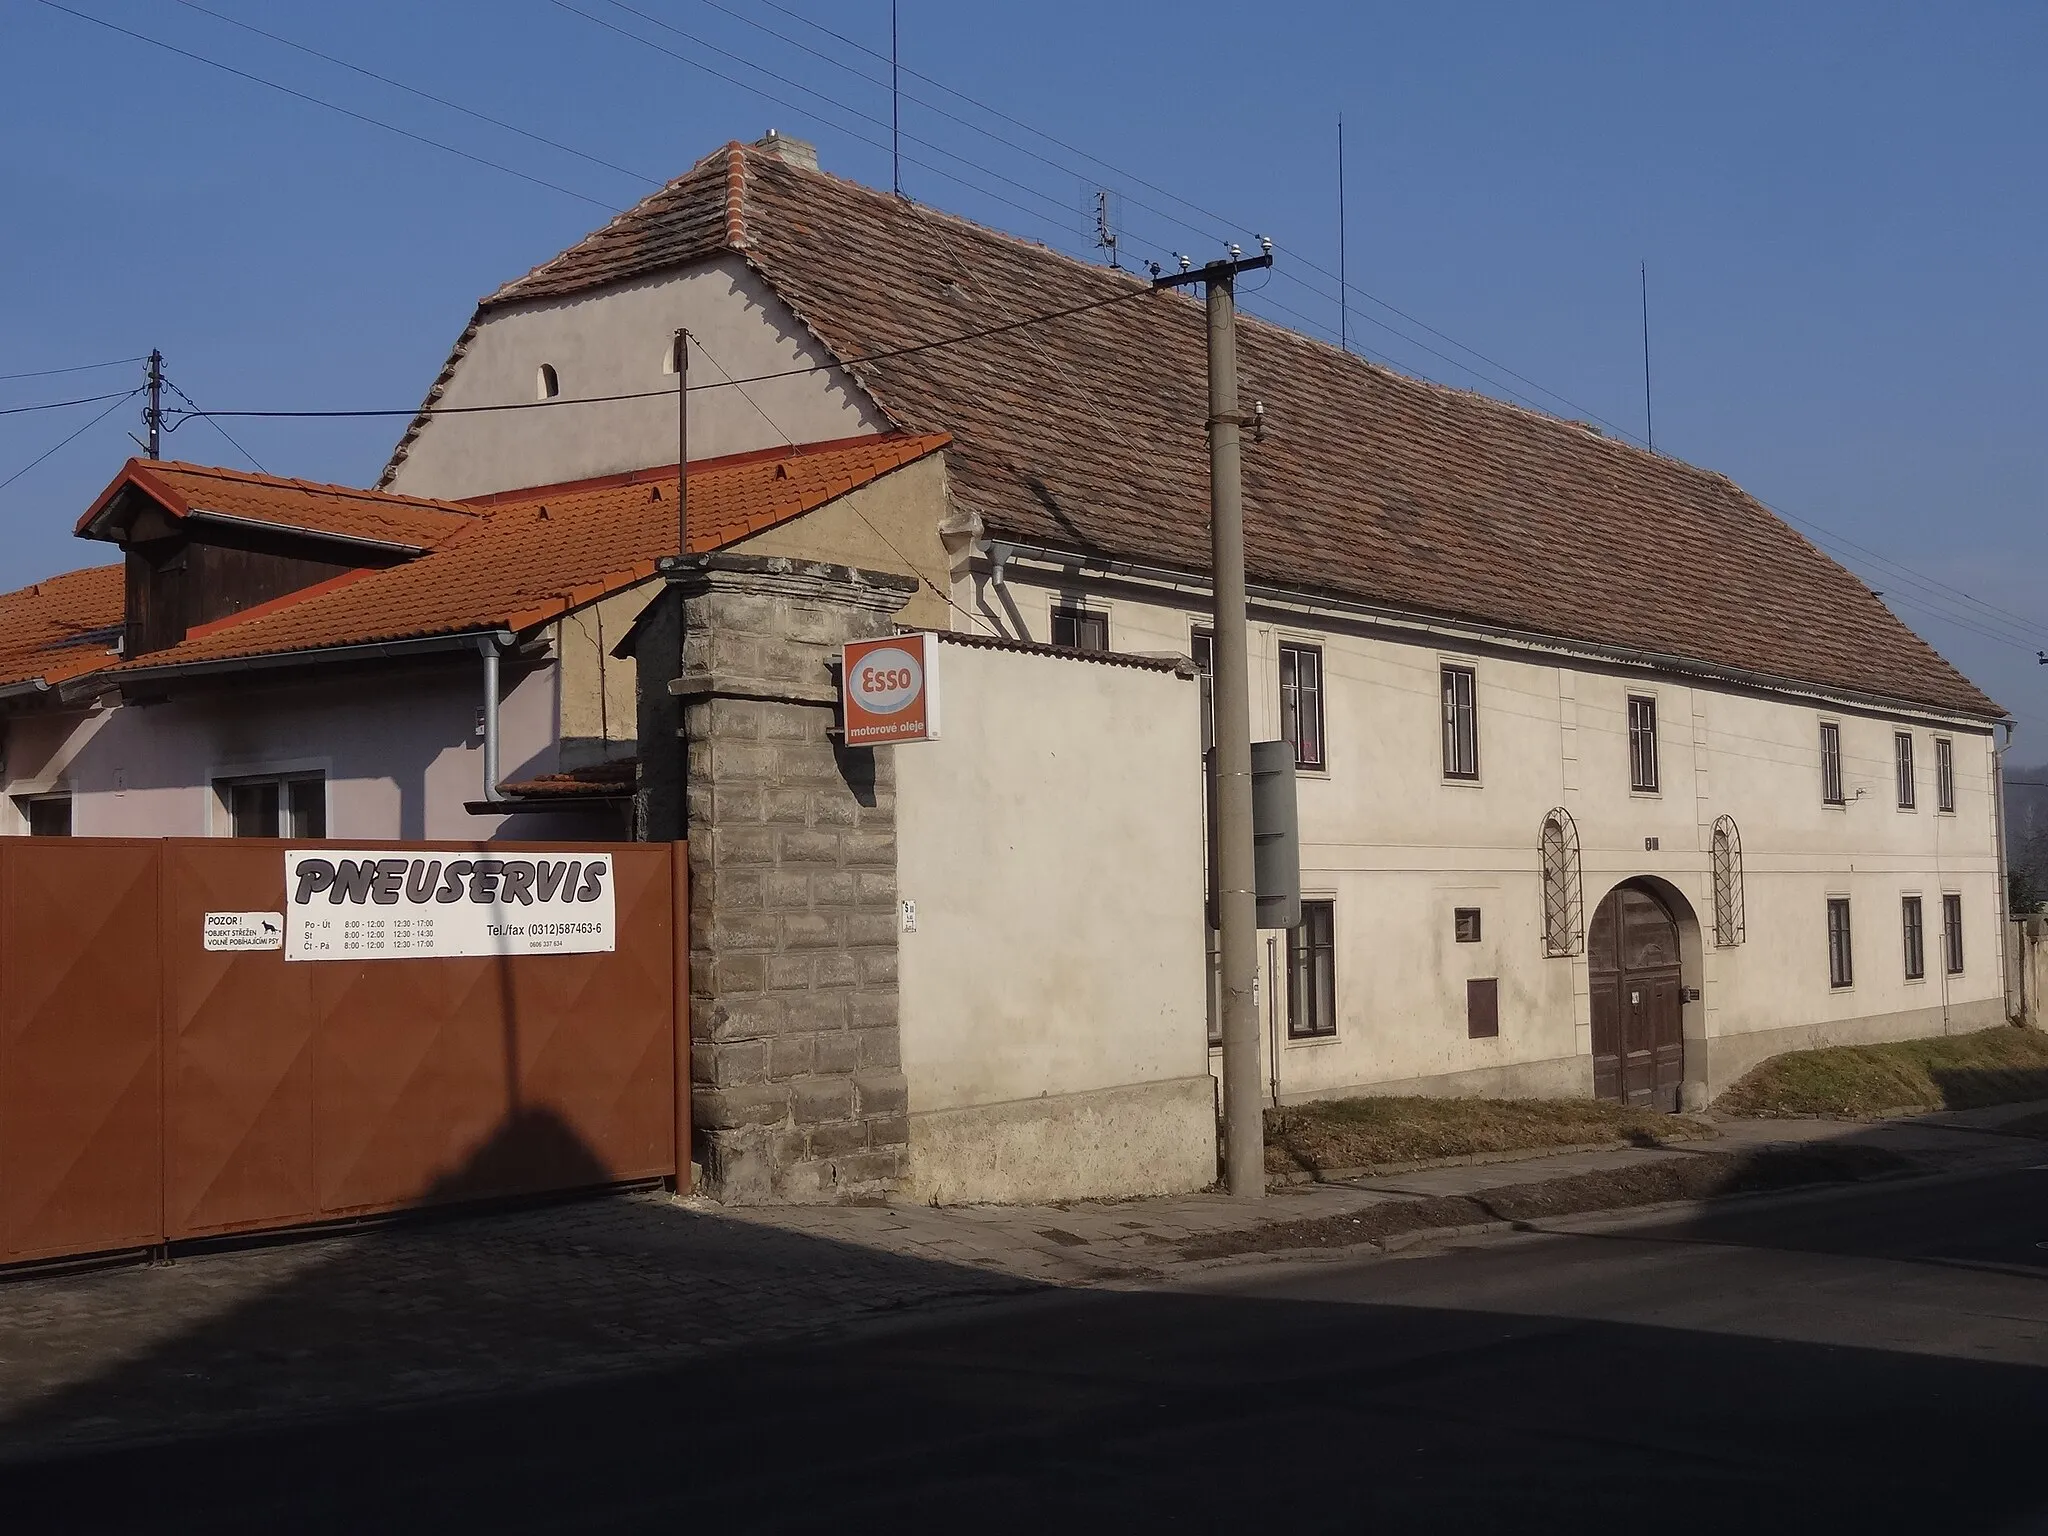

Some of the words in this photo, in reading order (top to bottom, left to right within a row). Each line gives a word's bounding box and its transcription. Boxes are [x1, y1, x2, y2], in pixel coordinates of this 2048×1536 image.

[850, 722, 897, 737] motorové
[900, 720, 924, 733] oleje
[295, 858, 607, 906] PNEUSERVIS
[208, 916, 238, 925] POZOR
[305, 921, 315, 929] Po
[344, 920, 360, 928] 8:00
[366, 920, 385, 928] 12:00
[394, 920, 411, 928] 12:30
[416, 919, 434, 927] 17:00
[207, 929, 231, 937] OBJEKT
[231, 928, 257, 937] STŘEŽEN
[394, 930, 411, 938] 12:30
[416, 929, 434, 937] 14:30
[487, 924, 525, 936] Tel./fax
[528, 922, 602, 937] (0312)587463-6
[304, 932, 313, 940] St
[344, 931, 360, 939] 8:00
[366, 931, 385, 939] 12:00
[207, 938, 228, 946] VOLNĚ
[304, 941, 313, 950] Čt
[344, 942, 360, 950] 8:00
[366, 941, 385, 949] 12:00
[394, 941, 411, 949] 12:30
[416, 940, 434, 948] 17:00
